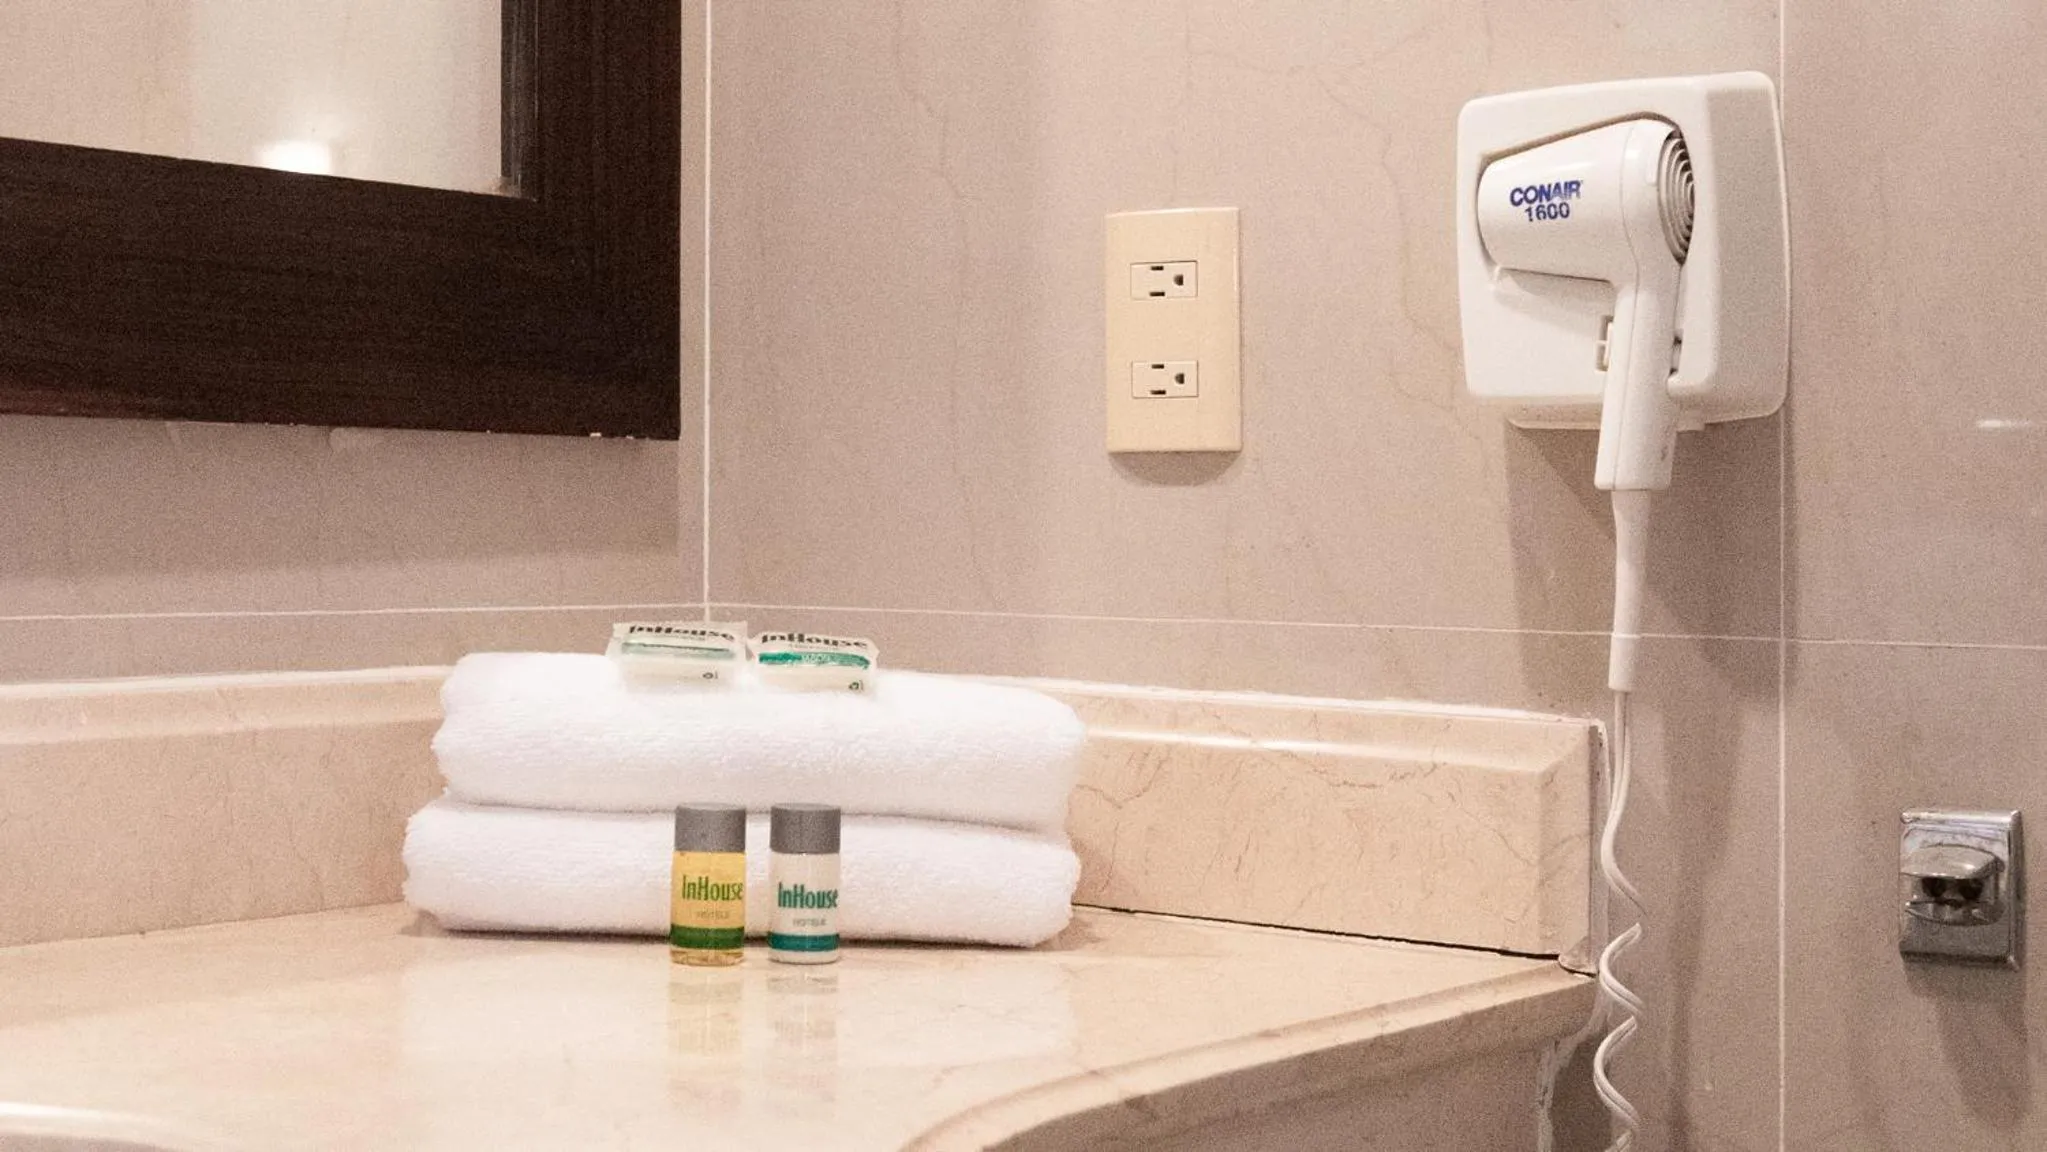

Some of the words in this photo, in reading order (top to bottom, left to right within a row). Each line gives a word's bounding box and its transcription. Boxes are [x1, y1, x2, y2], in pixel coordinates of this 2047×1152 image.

[1510, 180, 1581, 207] CONAIR
[1525, 202, 1570, 222] 1600
[762, 633, 867, 648] InHouse
[682, 875, 744, 900] InHouse
[777, 882, 838, 908] InHouse
